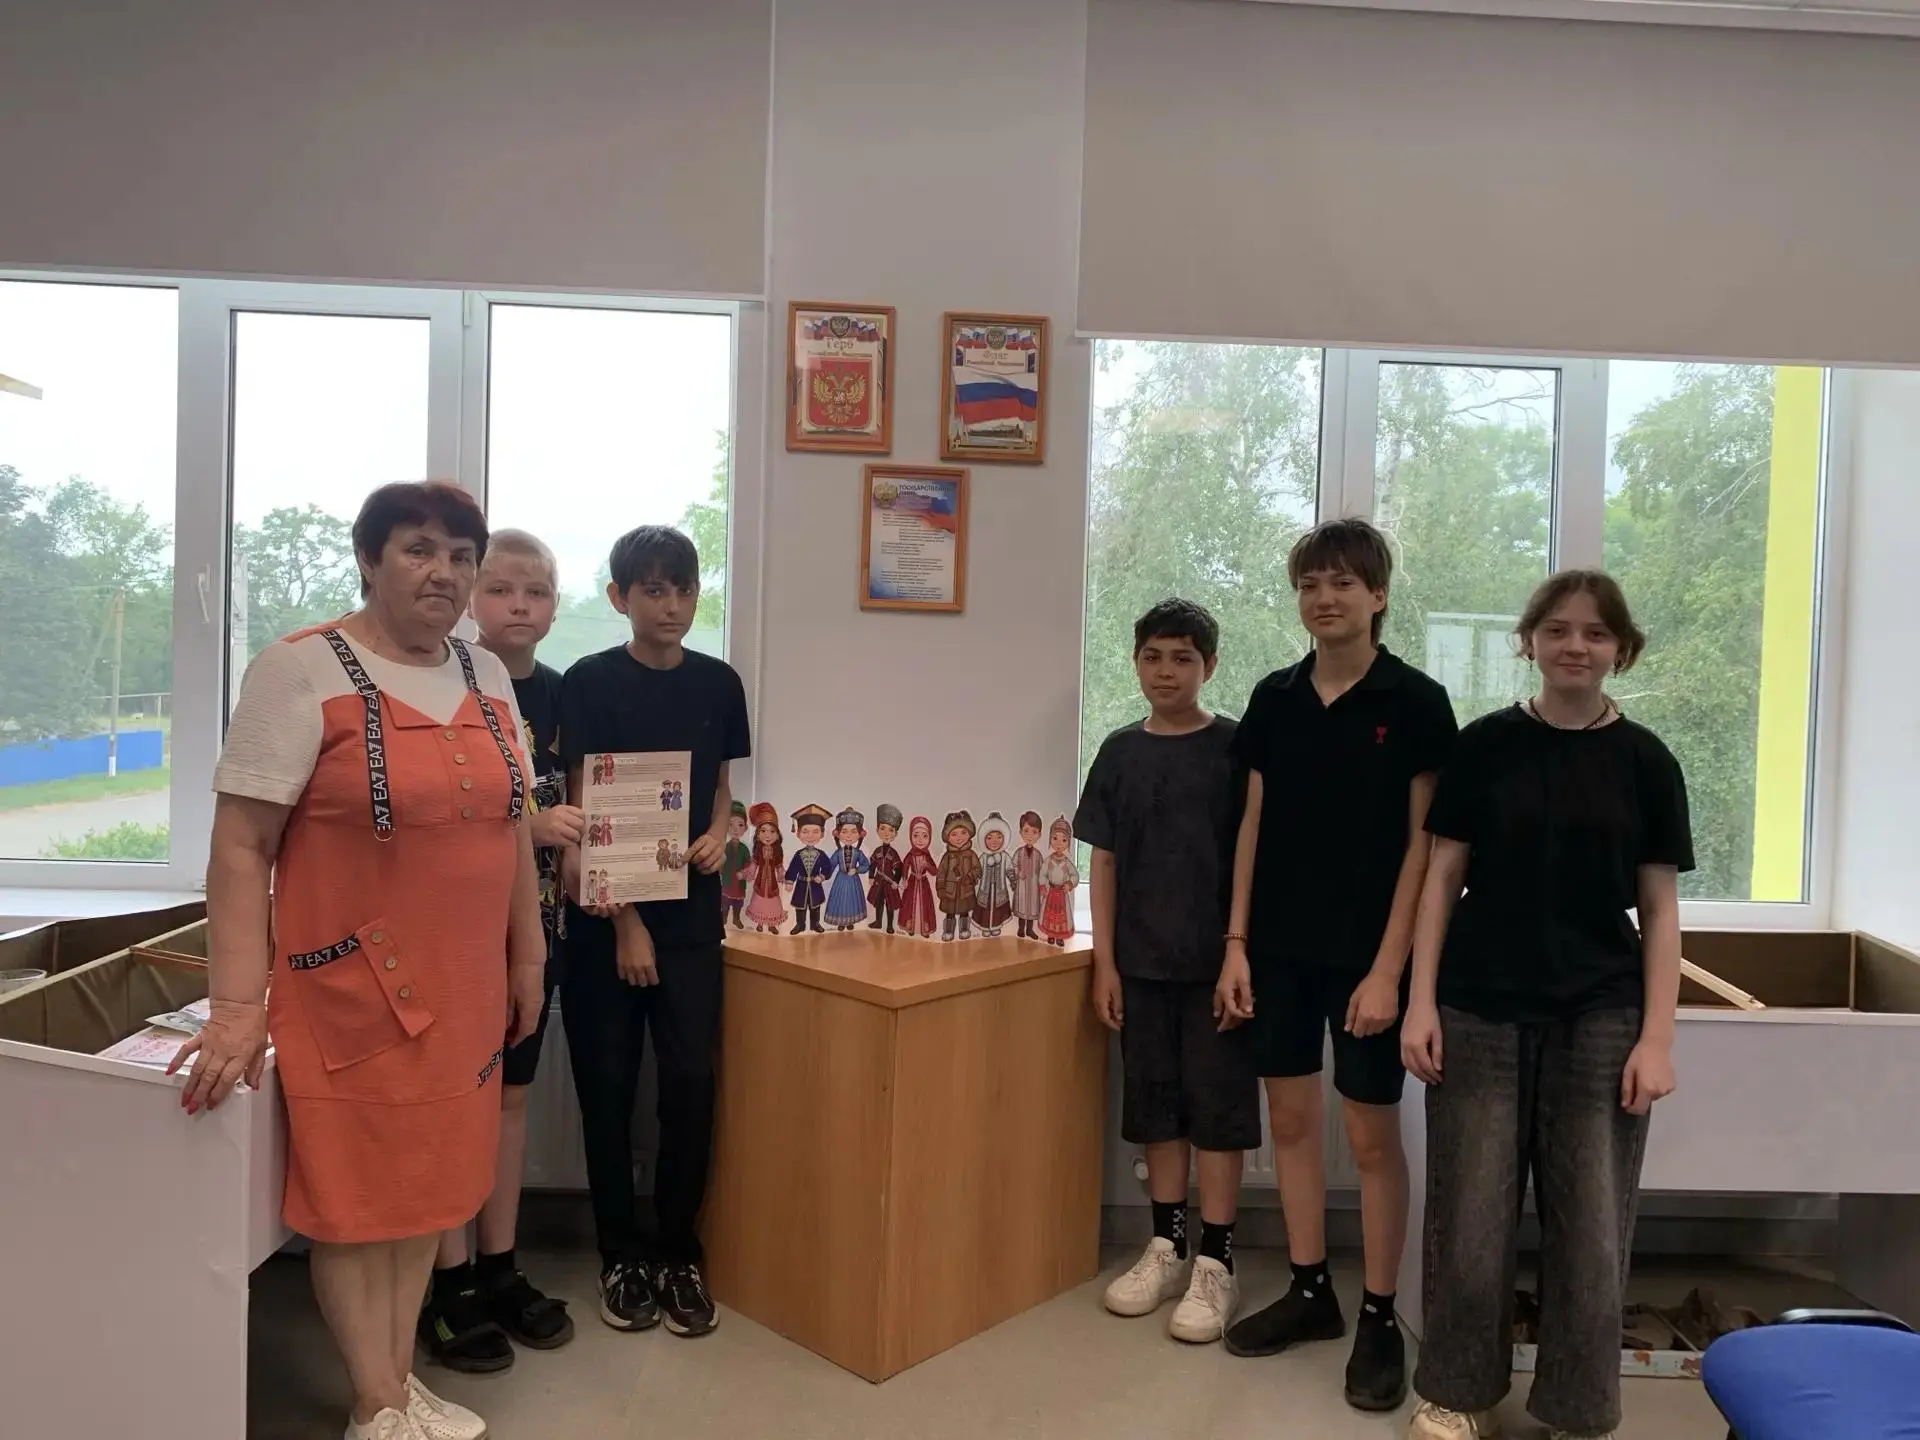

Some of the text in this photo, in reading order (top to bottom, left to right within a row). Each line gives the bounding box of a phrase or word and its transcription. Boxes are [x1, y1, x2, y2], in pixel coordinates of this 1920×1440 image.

[331, 640, 355, 662] EA7
[367, 710, 381, 739] EA7
[368, 742, 384, 769] EA7
[486, 715, 503, 739] EA7
[498, 740, 516, 764] EA7
[510, 766, 523, 795] EA7
[371, 771, 388, 801] EA7
[306, 947, 332, 967] EA7
